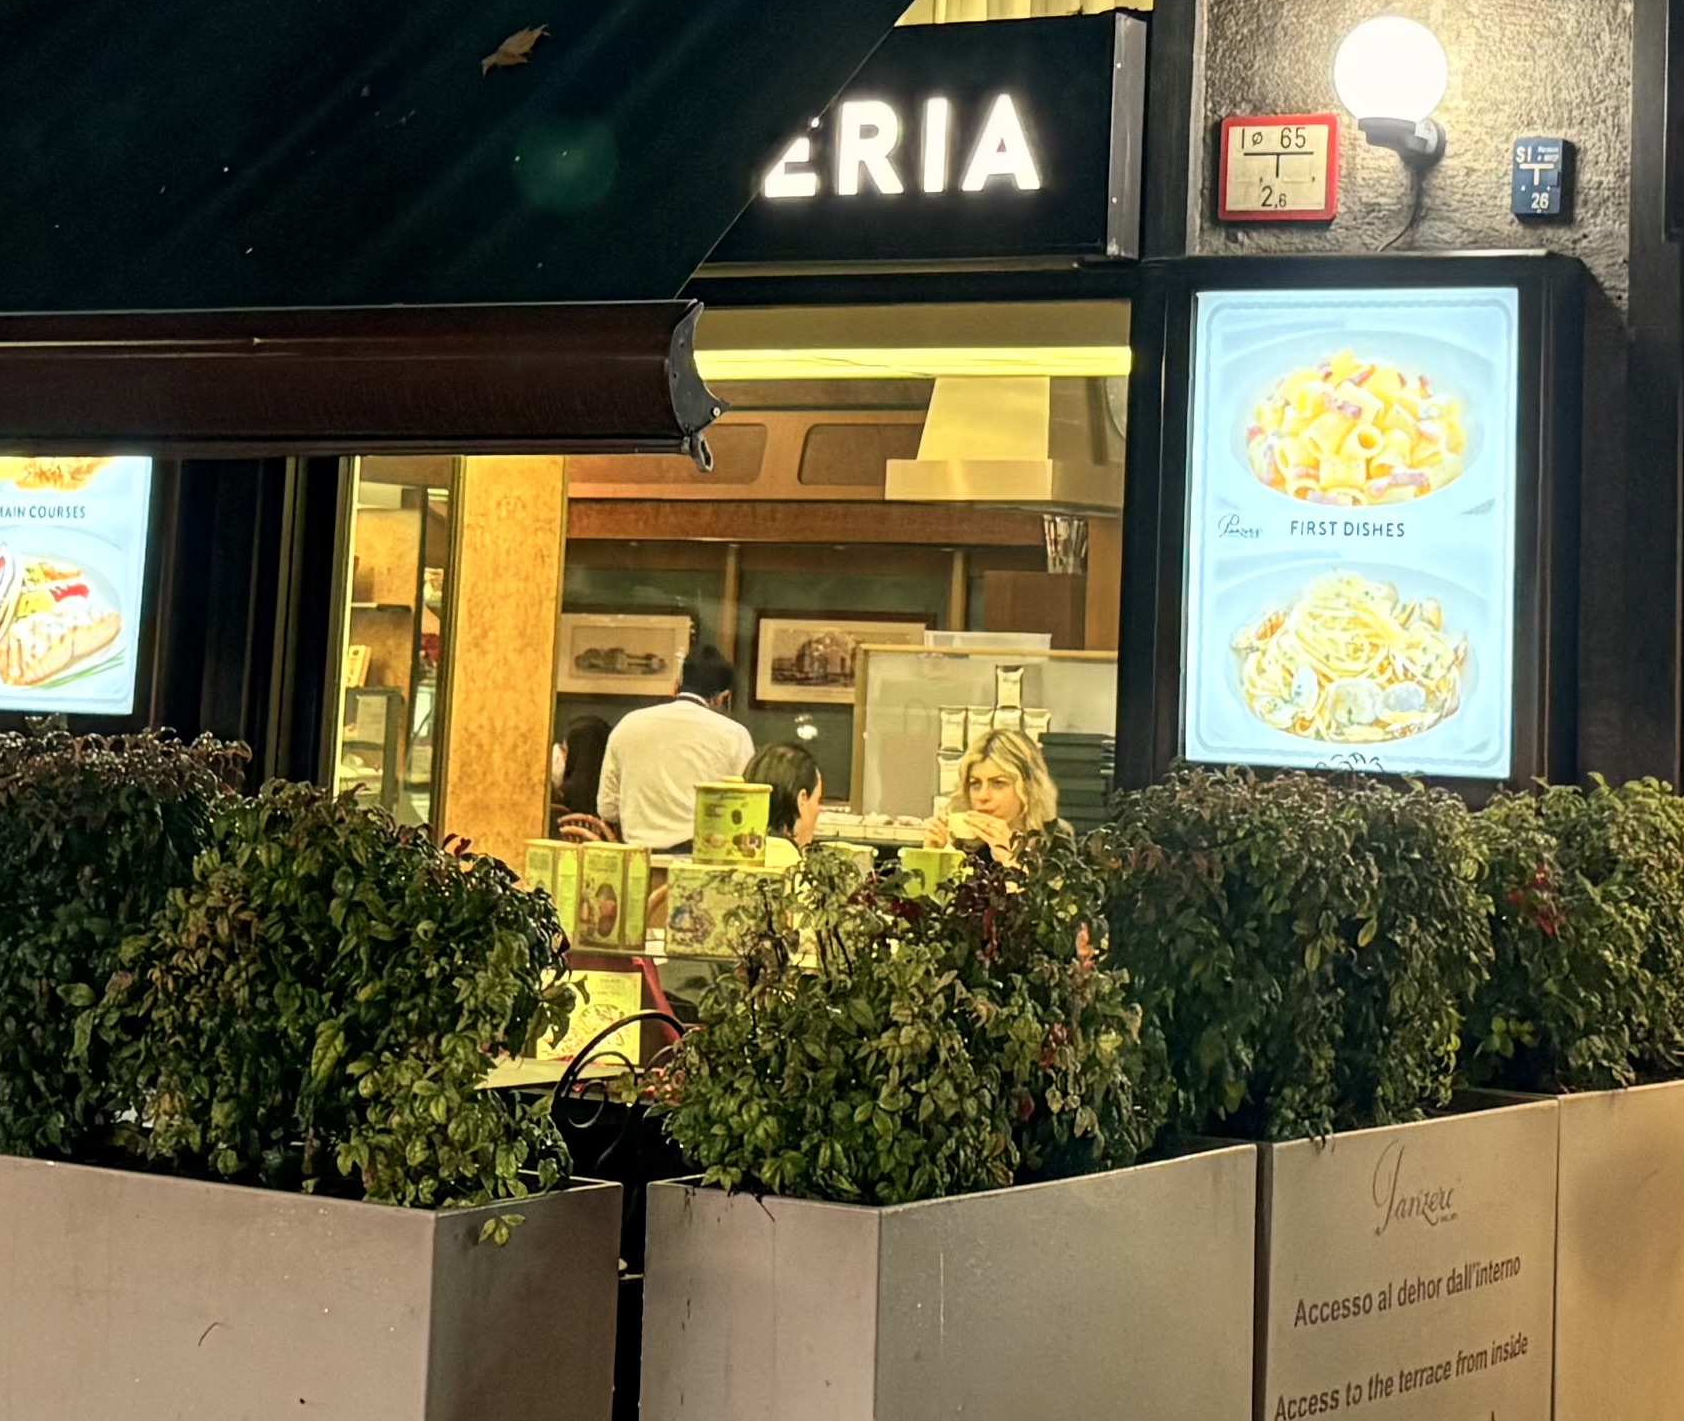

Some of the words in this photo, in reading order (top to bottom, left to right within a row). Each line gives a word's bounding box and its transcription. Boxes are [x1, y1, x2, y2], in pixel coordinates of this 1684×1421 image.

[1280, 126, 1307, 149] 65
[28, 505, 87, 520] COURSES
[1290, 520, 1338, 536] FIRST
[1343, 521, 1406, 537] DISHES
[1294, 1293, 1373, 1328] Accesso
[1377, 1282, 1393, 1312] al
[1397, 1277, 1442, 1307] dehor
[1446, 1254, 1521, 1296] dall'interno
[1274, 1380, 1340, 1421] Access
[1345, 1380, 1362, 1407] to
[1368, 1371, 1394, 1400] the
[1398, 1360, 1452, 1392] terrace
[1455, 1349, 1488, 1377] from
[1490, 1331, 1528, 1366] inside
